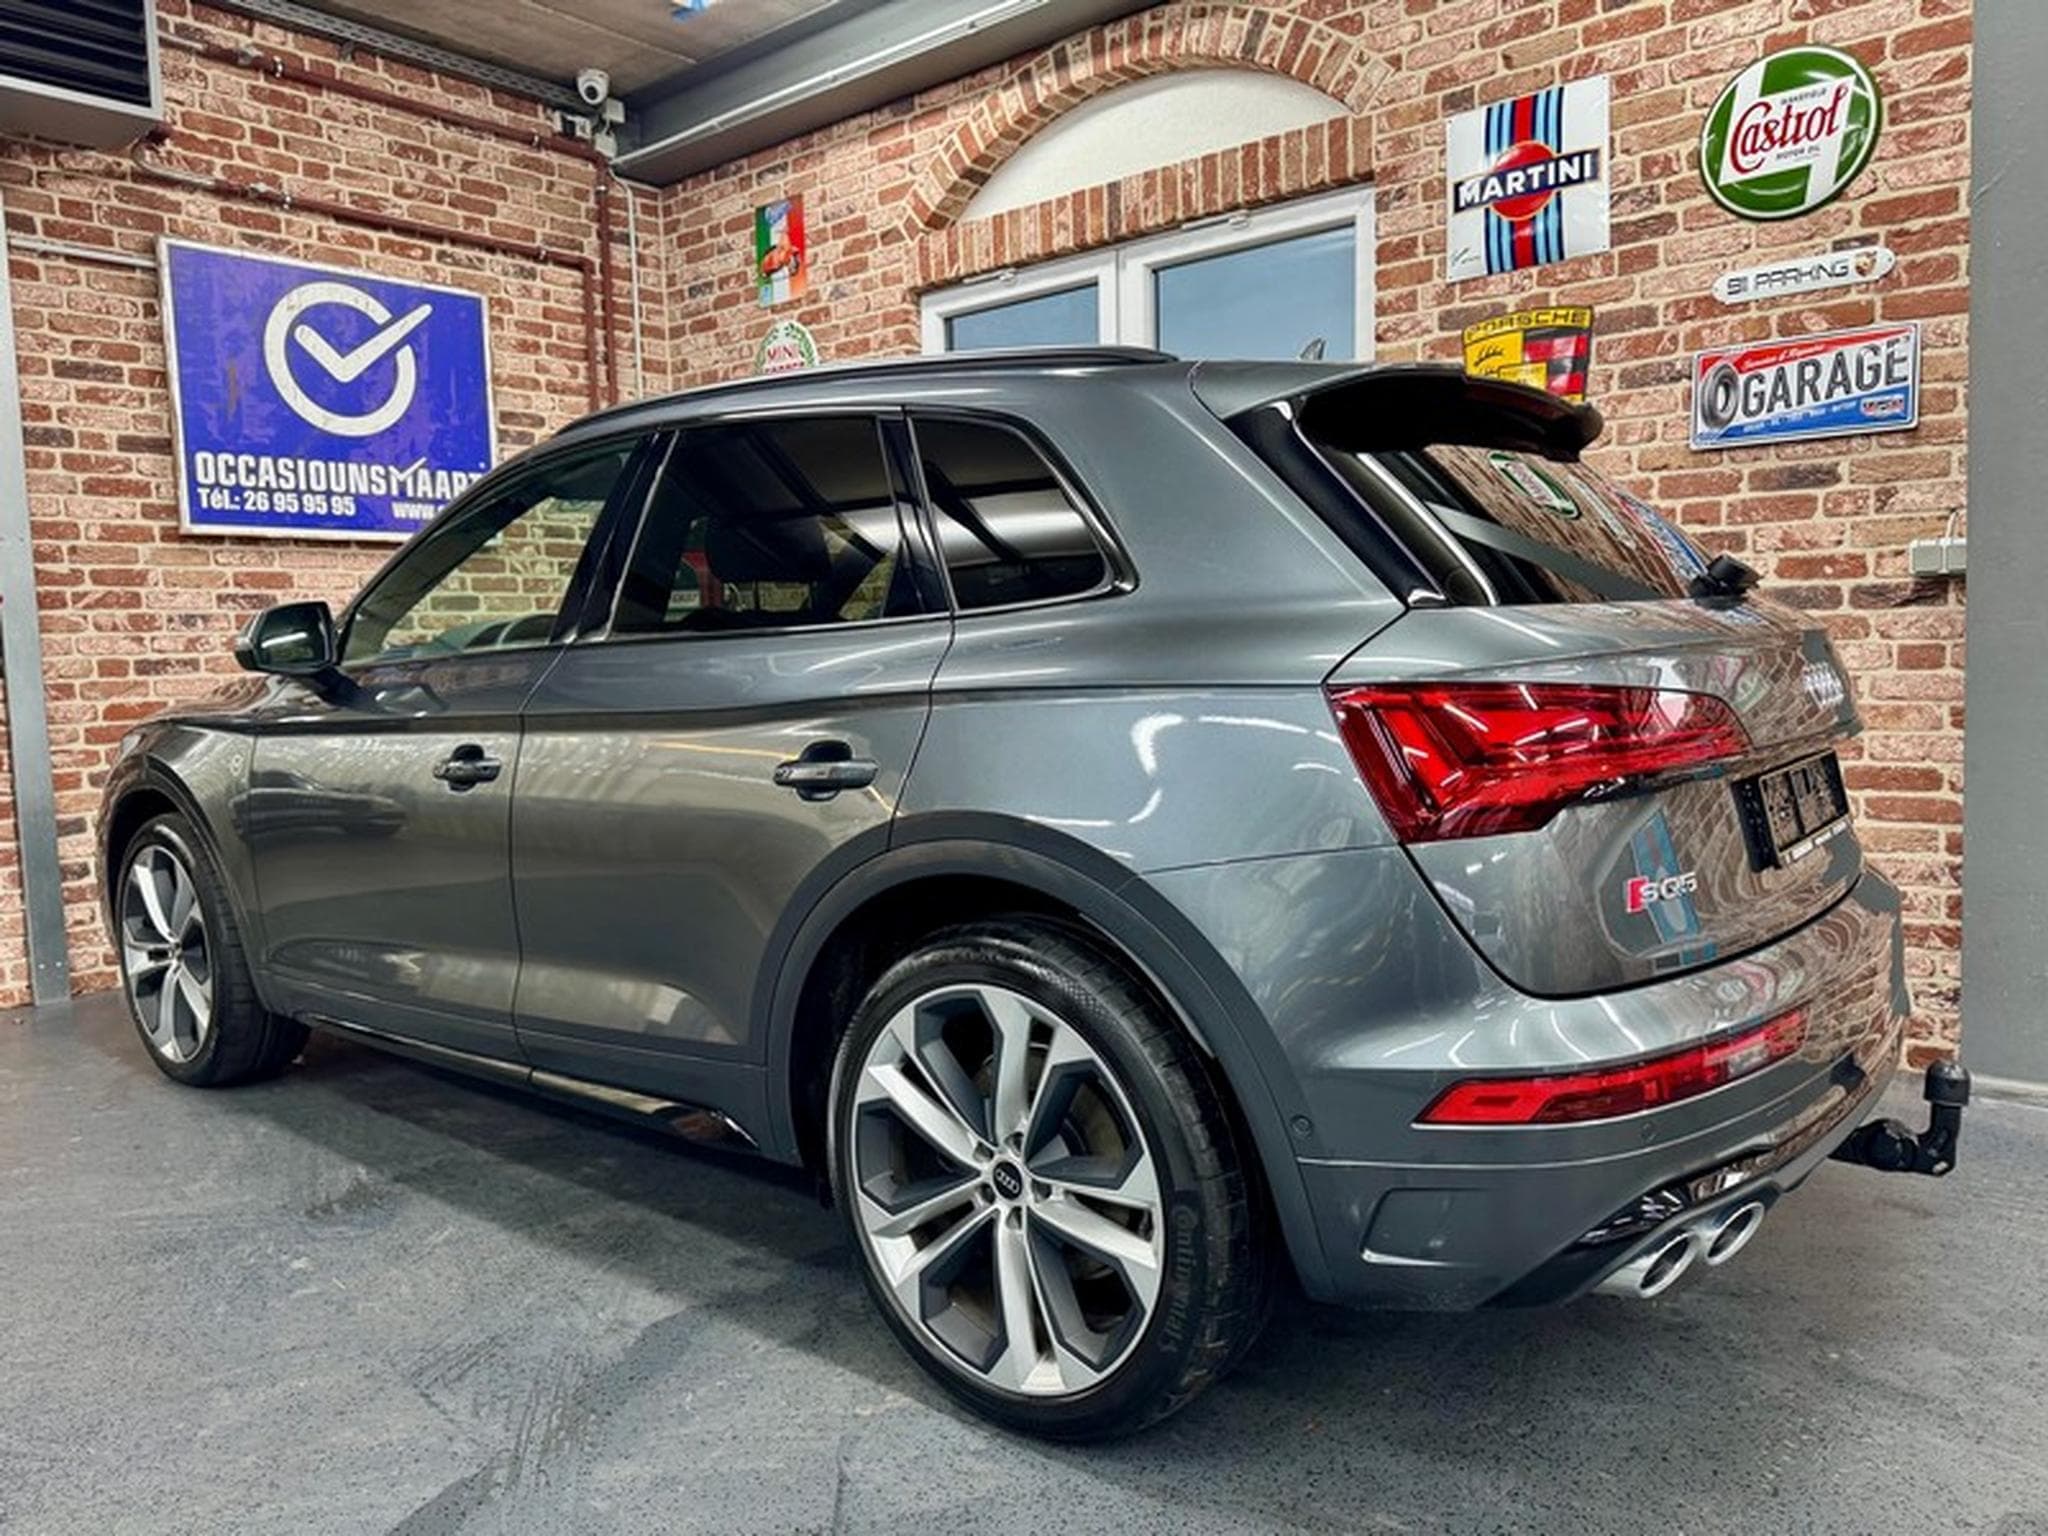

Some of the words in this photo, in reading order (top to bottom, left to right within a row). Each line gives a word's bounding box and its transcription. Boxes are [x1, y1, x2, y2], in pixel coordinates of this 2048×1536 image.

[1729, 84, 1849, 174] Castrol
[1458, 153, 1592, 208] MARTINI
[1755, 258, 1849, 291] PARKING
[1741, 335, 1910, 418] GARAGE
[243, 490, 270, 513] 26
[273, 491, 299, 514] 95
[302, 493, 328, 515] 95
[331, 495, 357, 517] 95
